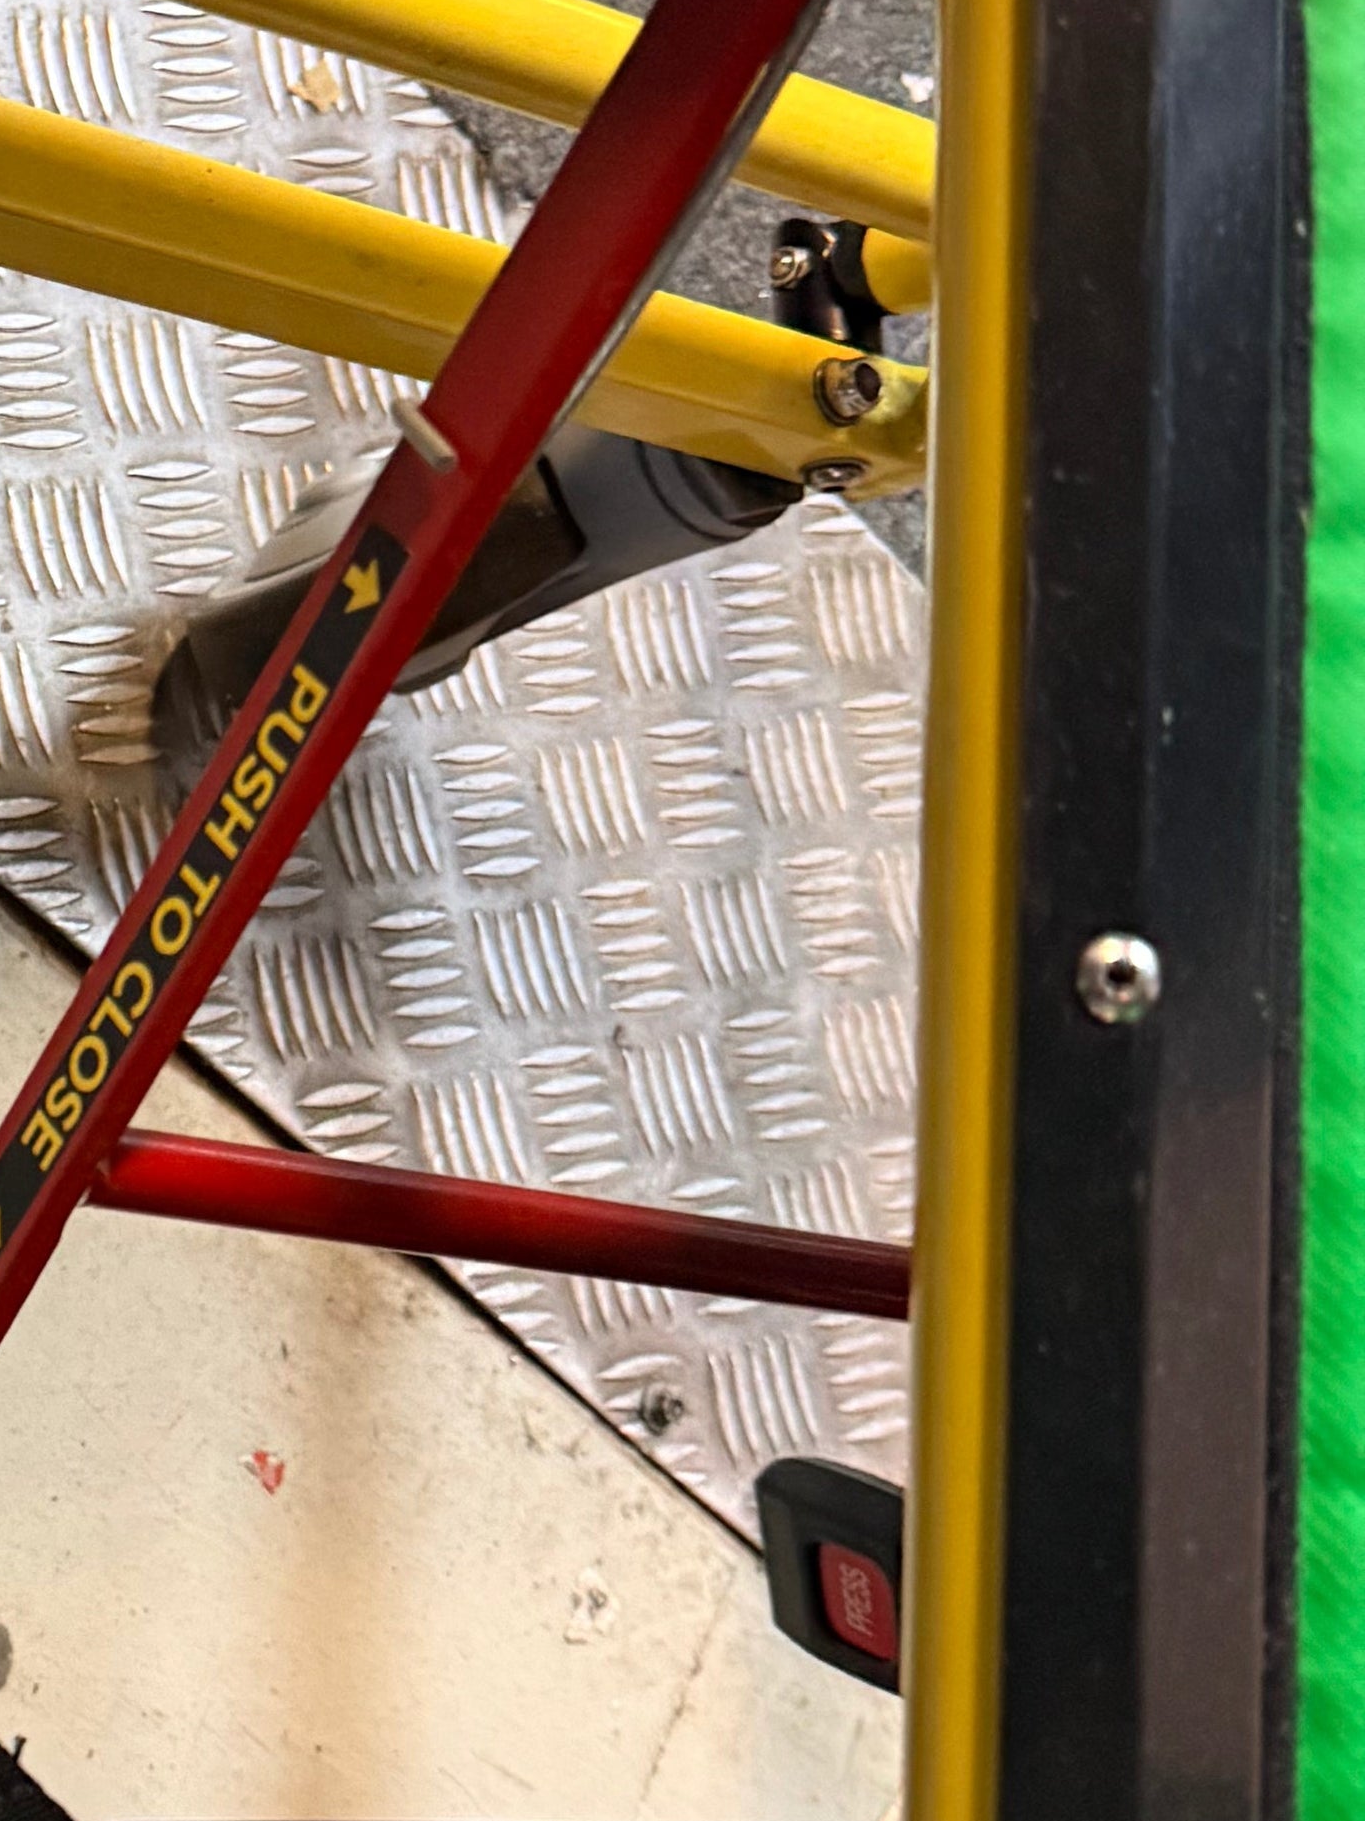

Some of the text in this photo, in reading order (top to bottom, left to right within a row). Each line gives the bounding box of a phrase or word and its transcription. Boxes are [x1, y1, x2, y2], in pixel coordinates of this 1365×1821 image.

[20, 664, 329, 1172] PUSH TO CLOSE
[838, 1562, 874, 1636] PRESS
